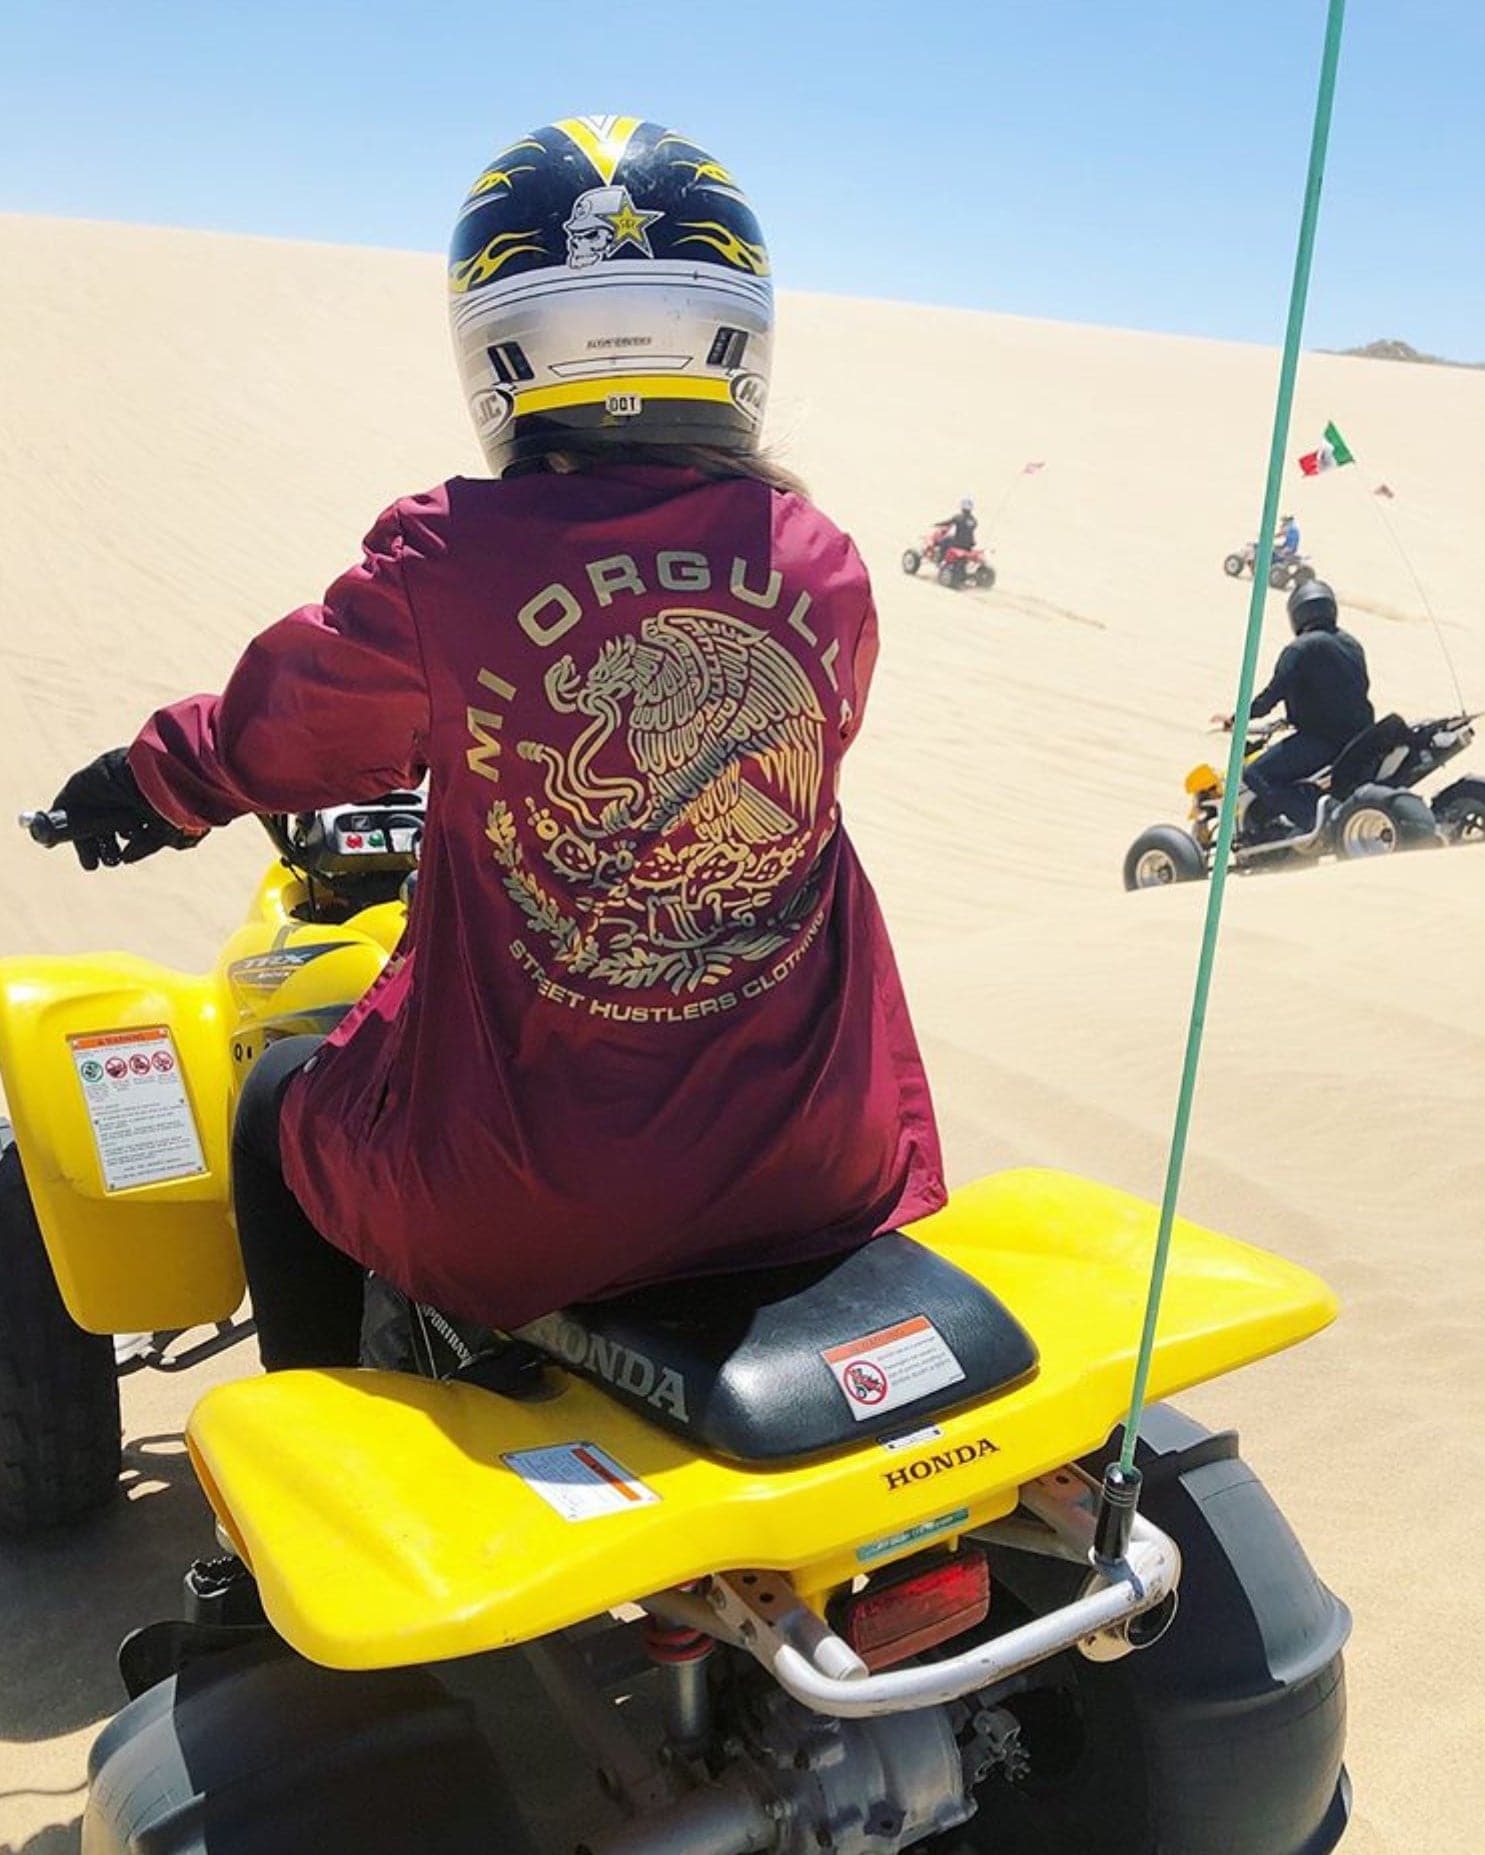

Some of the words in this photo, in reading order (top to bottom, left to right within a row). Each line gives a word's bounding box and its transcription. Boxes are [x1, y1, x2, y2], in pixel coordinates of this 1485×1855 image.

[467, 666, 517, 783] MI
[517, 550, 853, 724] ORGULL
[589, 992, 738, 1023] HUSTLERS
[883, 1437, 1001, 1491] HONDA
